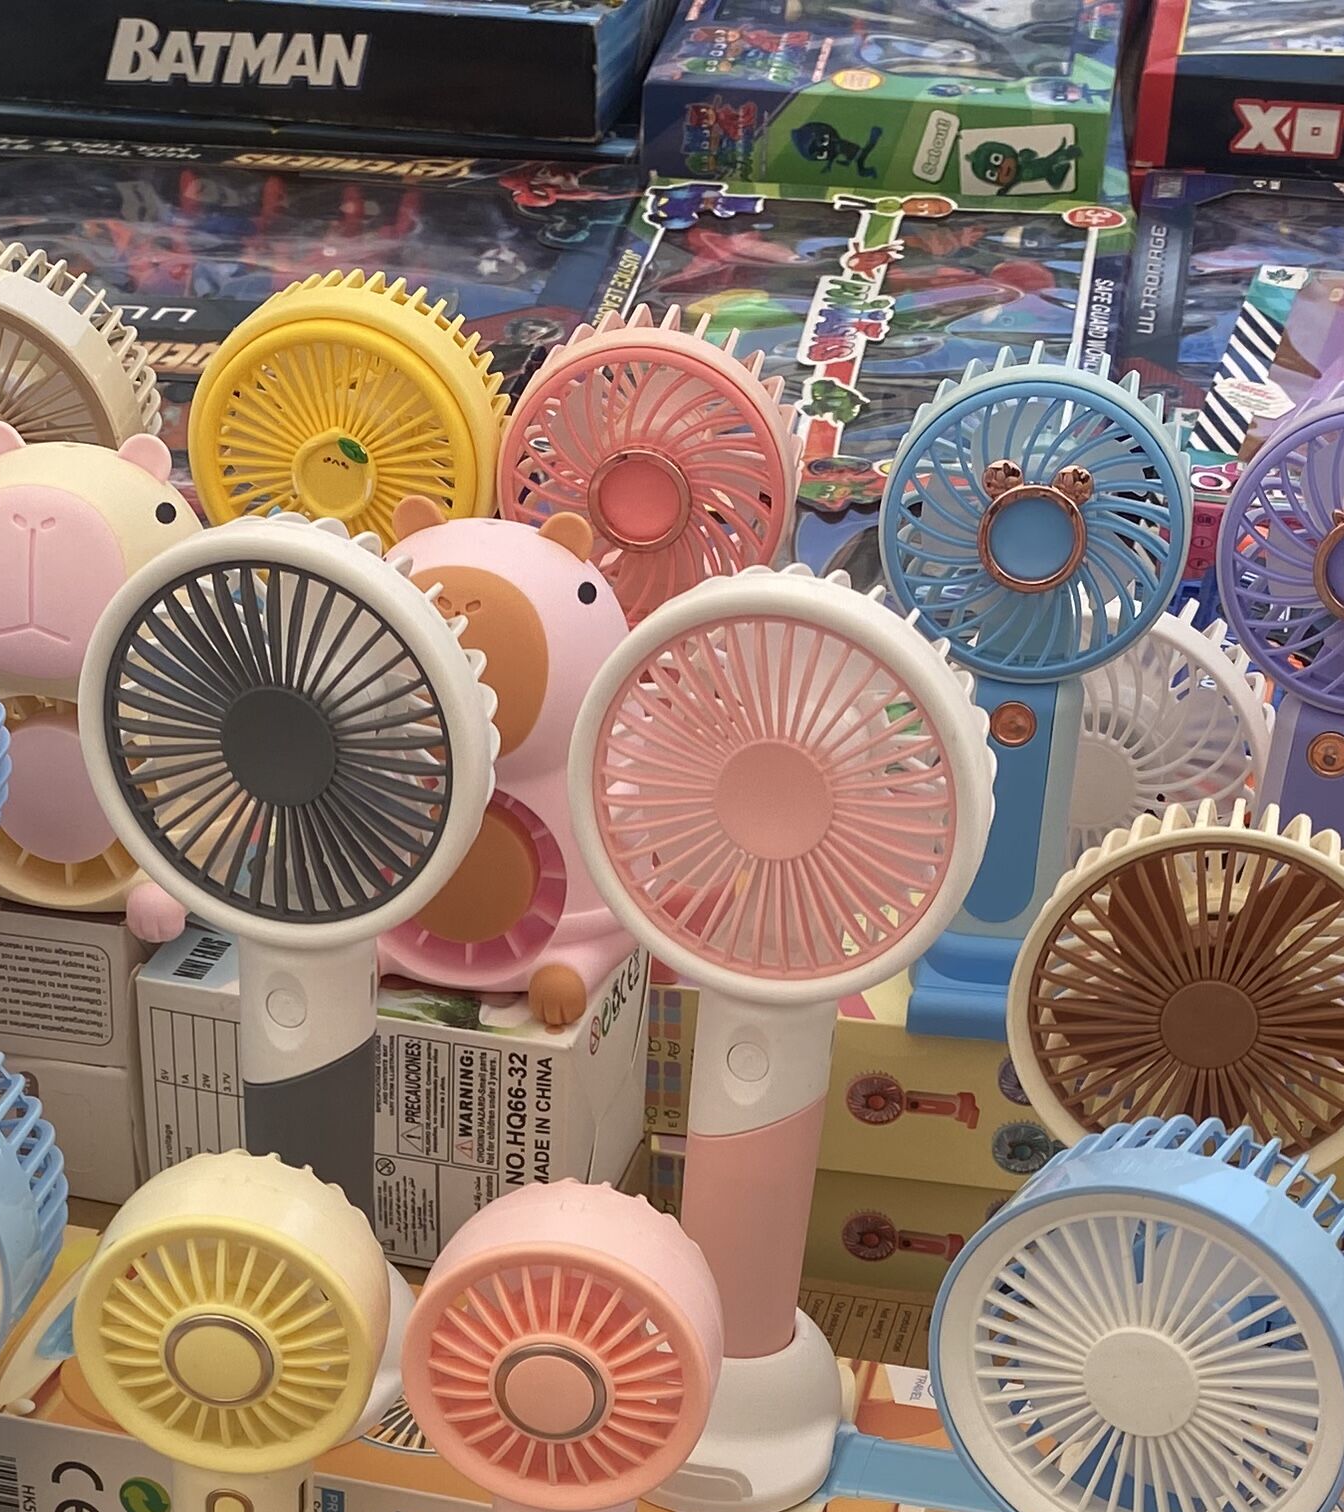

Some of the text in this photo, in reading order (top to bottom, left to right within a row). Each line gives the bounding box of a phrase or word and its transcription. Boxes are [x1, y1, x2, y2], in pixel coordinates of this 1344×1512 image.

[105, 17, 368, 88] BATMAN
[610, 248, 642, 289] JUSTICE
[1136, 224, 1167, 333] ULTRON AGE
[404, 1038, 421, 1124] PRECAUCIONES:
[458, 1048, 473, 1139] WARNING:
[478, 1051, 487, 1072] parts
[476, 1128, 484, 1163] CHOKING
[487, 1109, 495, 1140] children
[505, 1051, 527, 1186] NO.HQ66-32
[534, 1055, 552, 1185] MADE IN CHINA
